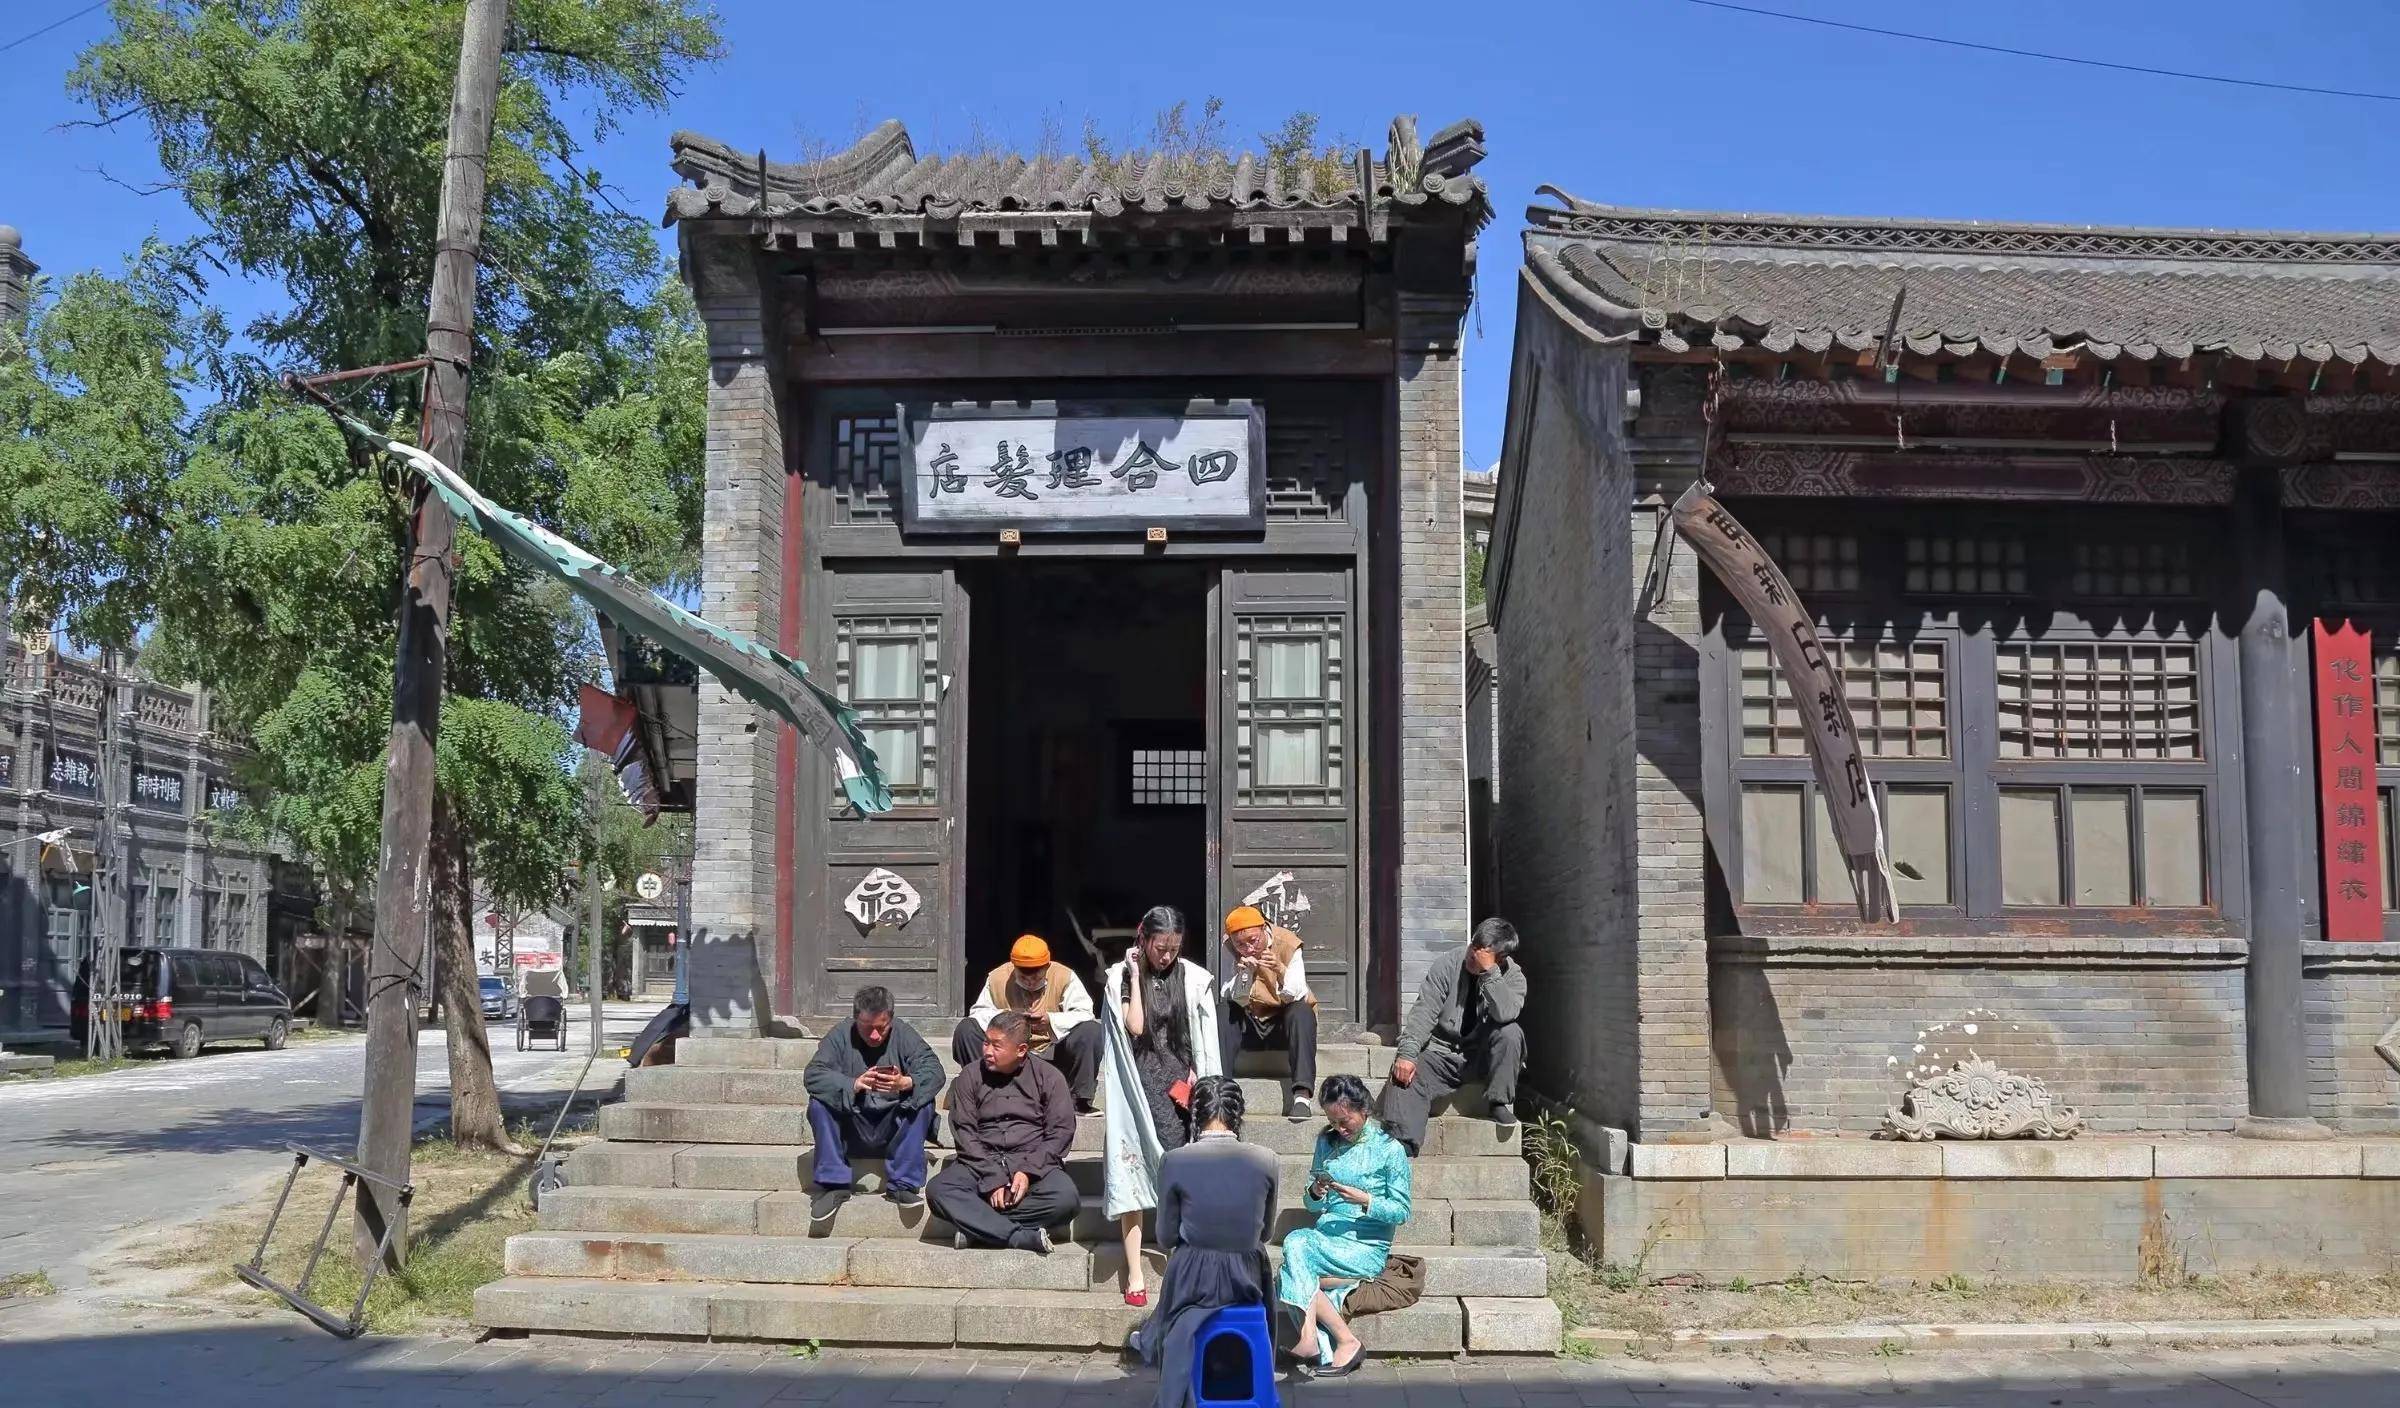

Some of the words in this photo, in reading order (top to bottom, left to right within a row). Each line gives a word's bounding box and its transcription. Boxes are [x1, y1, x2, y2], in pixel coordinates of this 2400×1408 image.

[929, 440, 1239, 501] 四合理髮店
